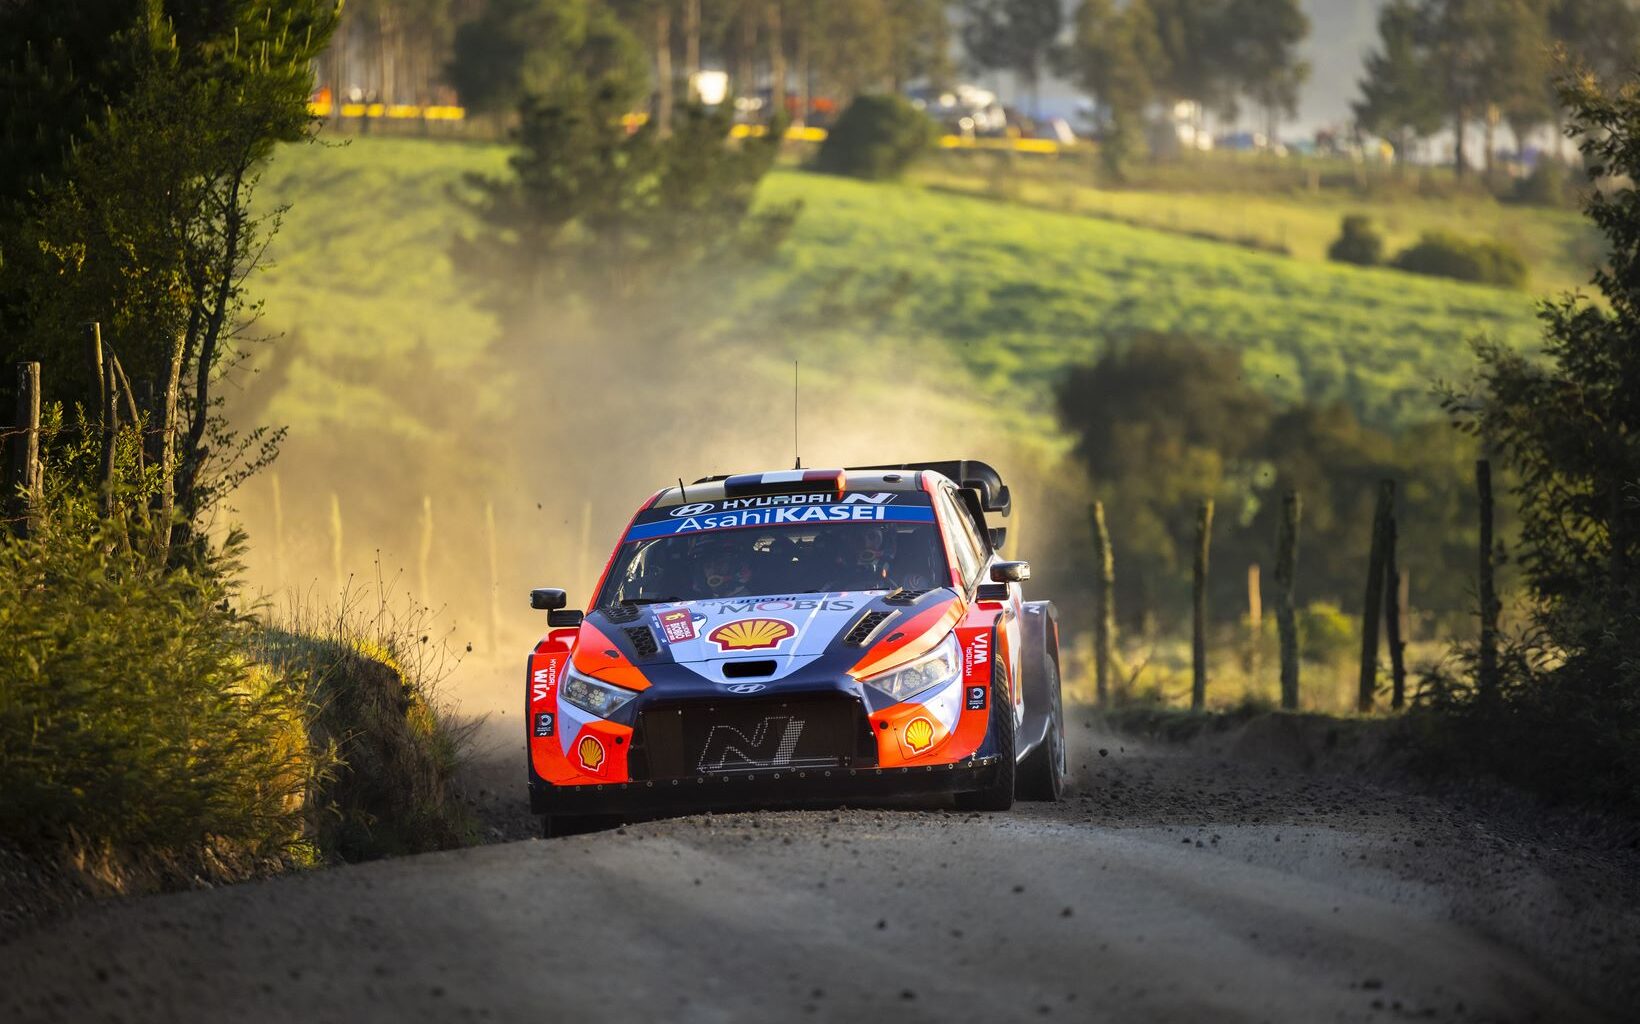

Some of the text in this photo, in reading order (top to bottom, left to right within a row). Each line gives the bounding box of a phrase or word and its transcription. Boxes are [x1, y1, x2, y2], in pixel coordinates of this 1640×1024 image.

[722, 494, 832, 510] HYUNDAI
[717, 600, 855, 615] MOBIS
[549, 658, 557, 686] HYUNDAI
[965, 646, 973, 677] HYUNDAI
